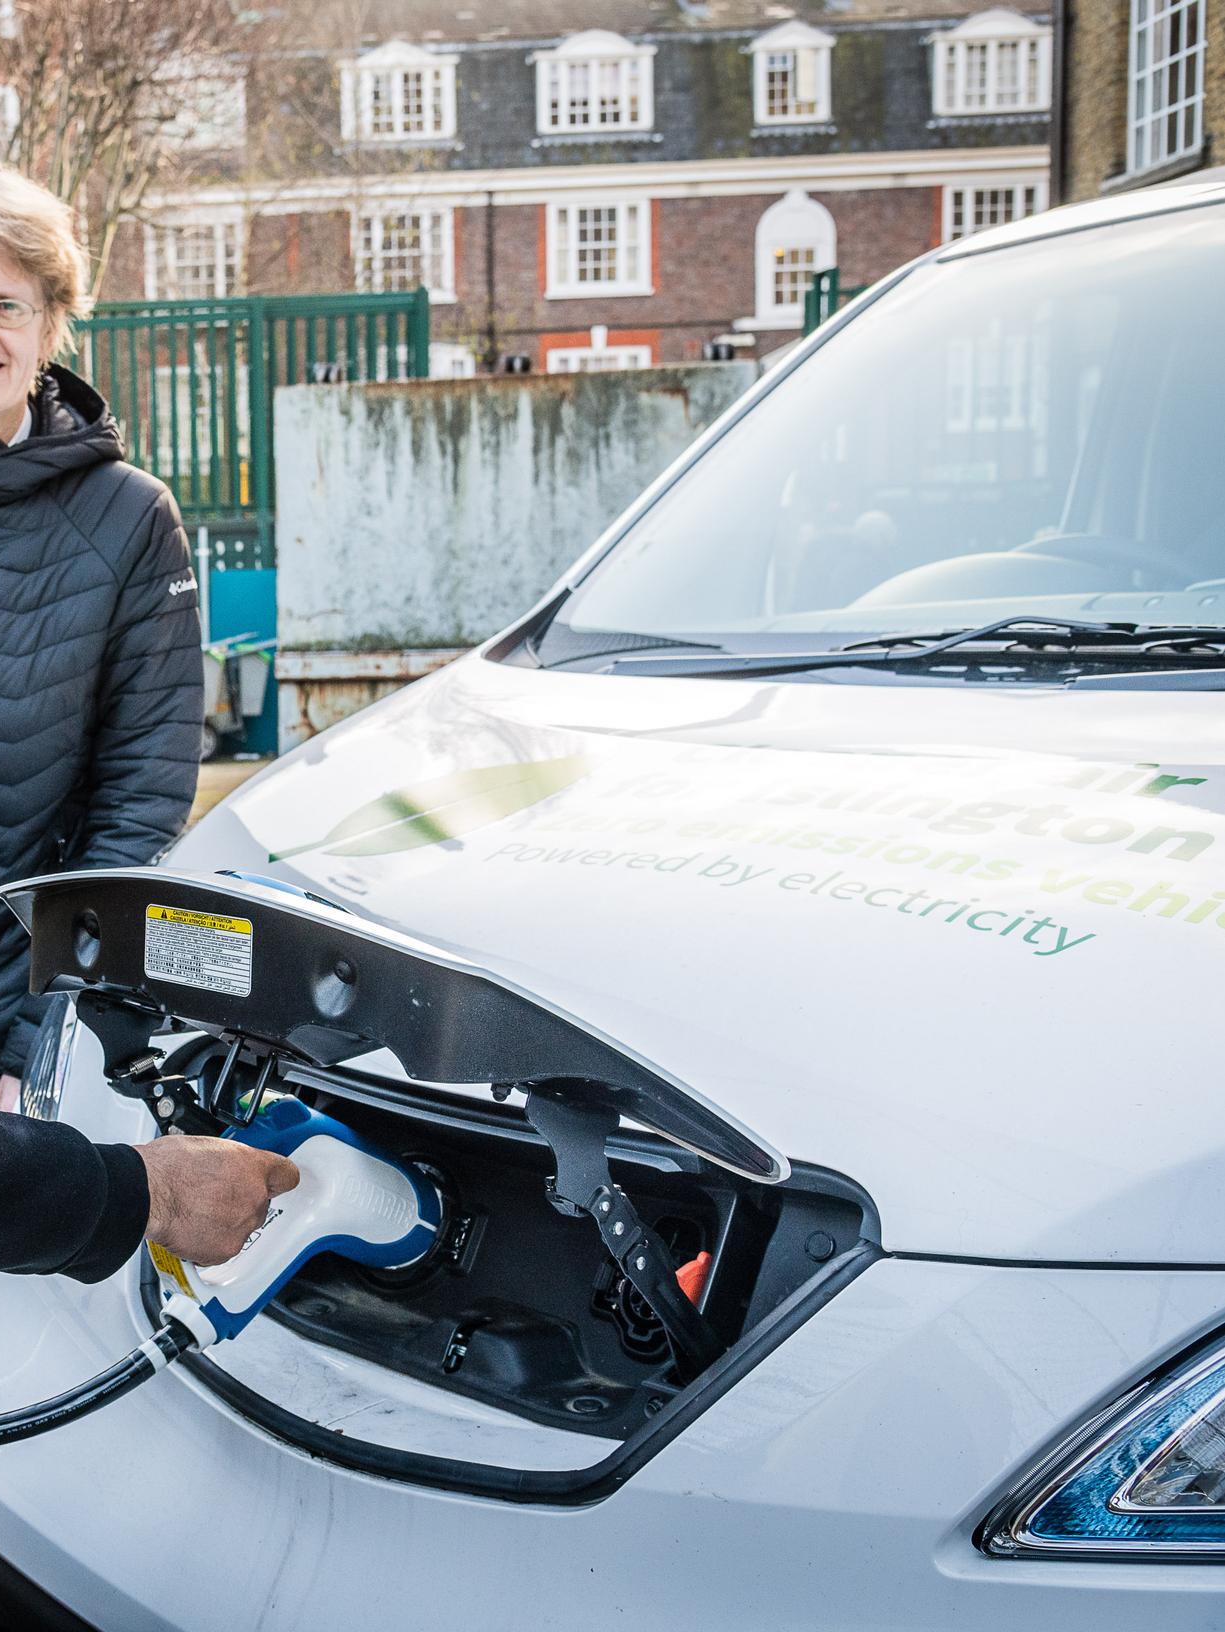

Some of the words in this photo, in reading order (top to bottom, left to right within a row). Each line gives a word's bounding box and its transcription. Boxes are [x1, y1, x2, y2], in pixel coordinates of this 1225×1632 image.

[483, 842, 704, 872] Powered
[697, 854, 775, 887] by
[778, 870, 1098, 957] electricity
[677, 820, 1023, 881] emissions
[1037, 867, 1225, 930] vehi
